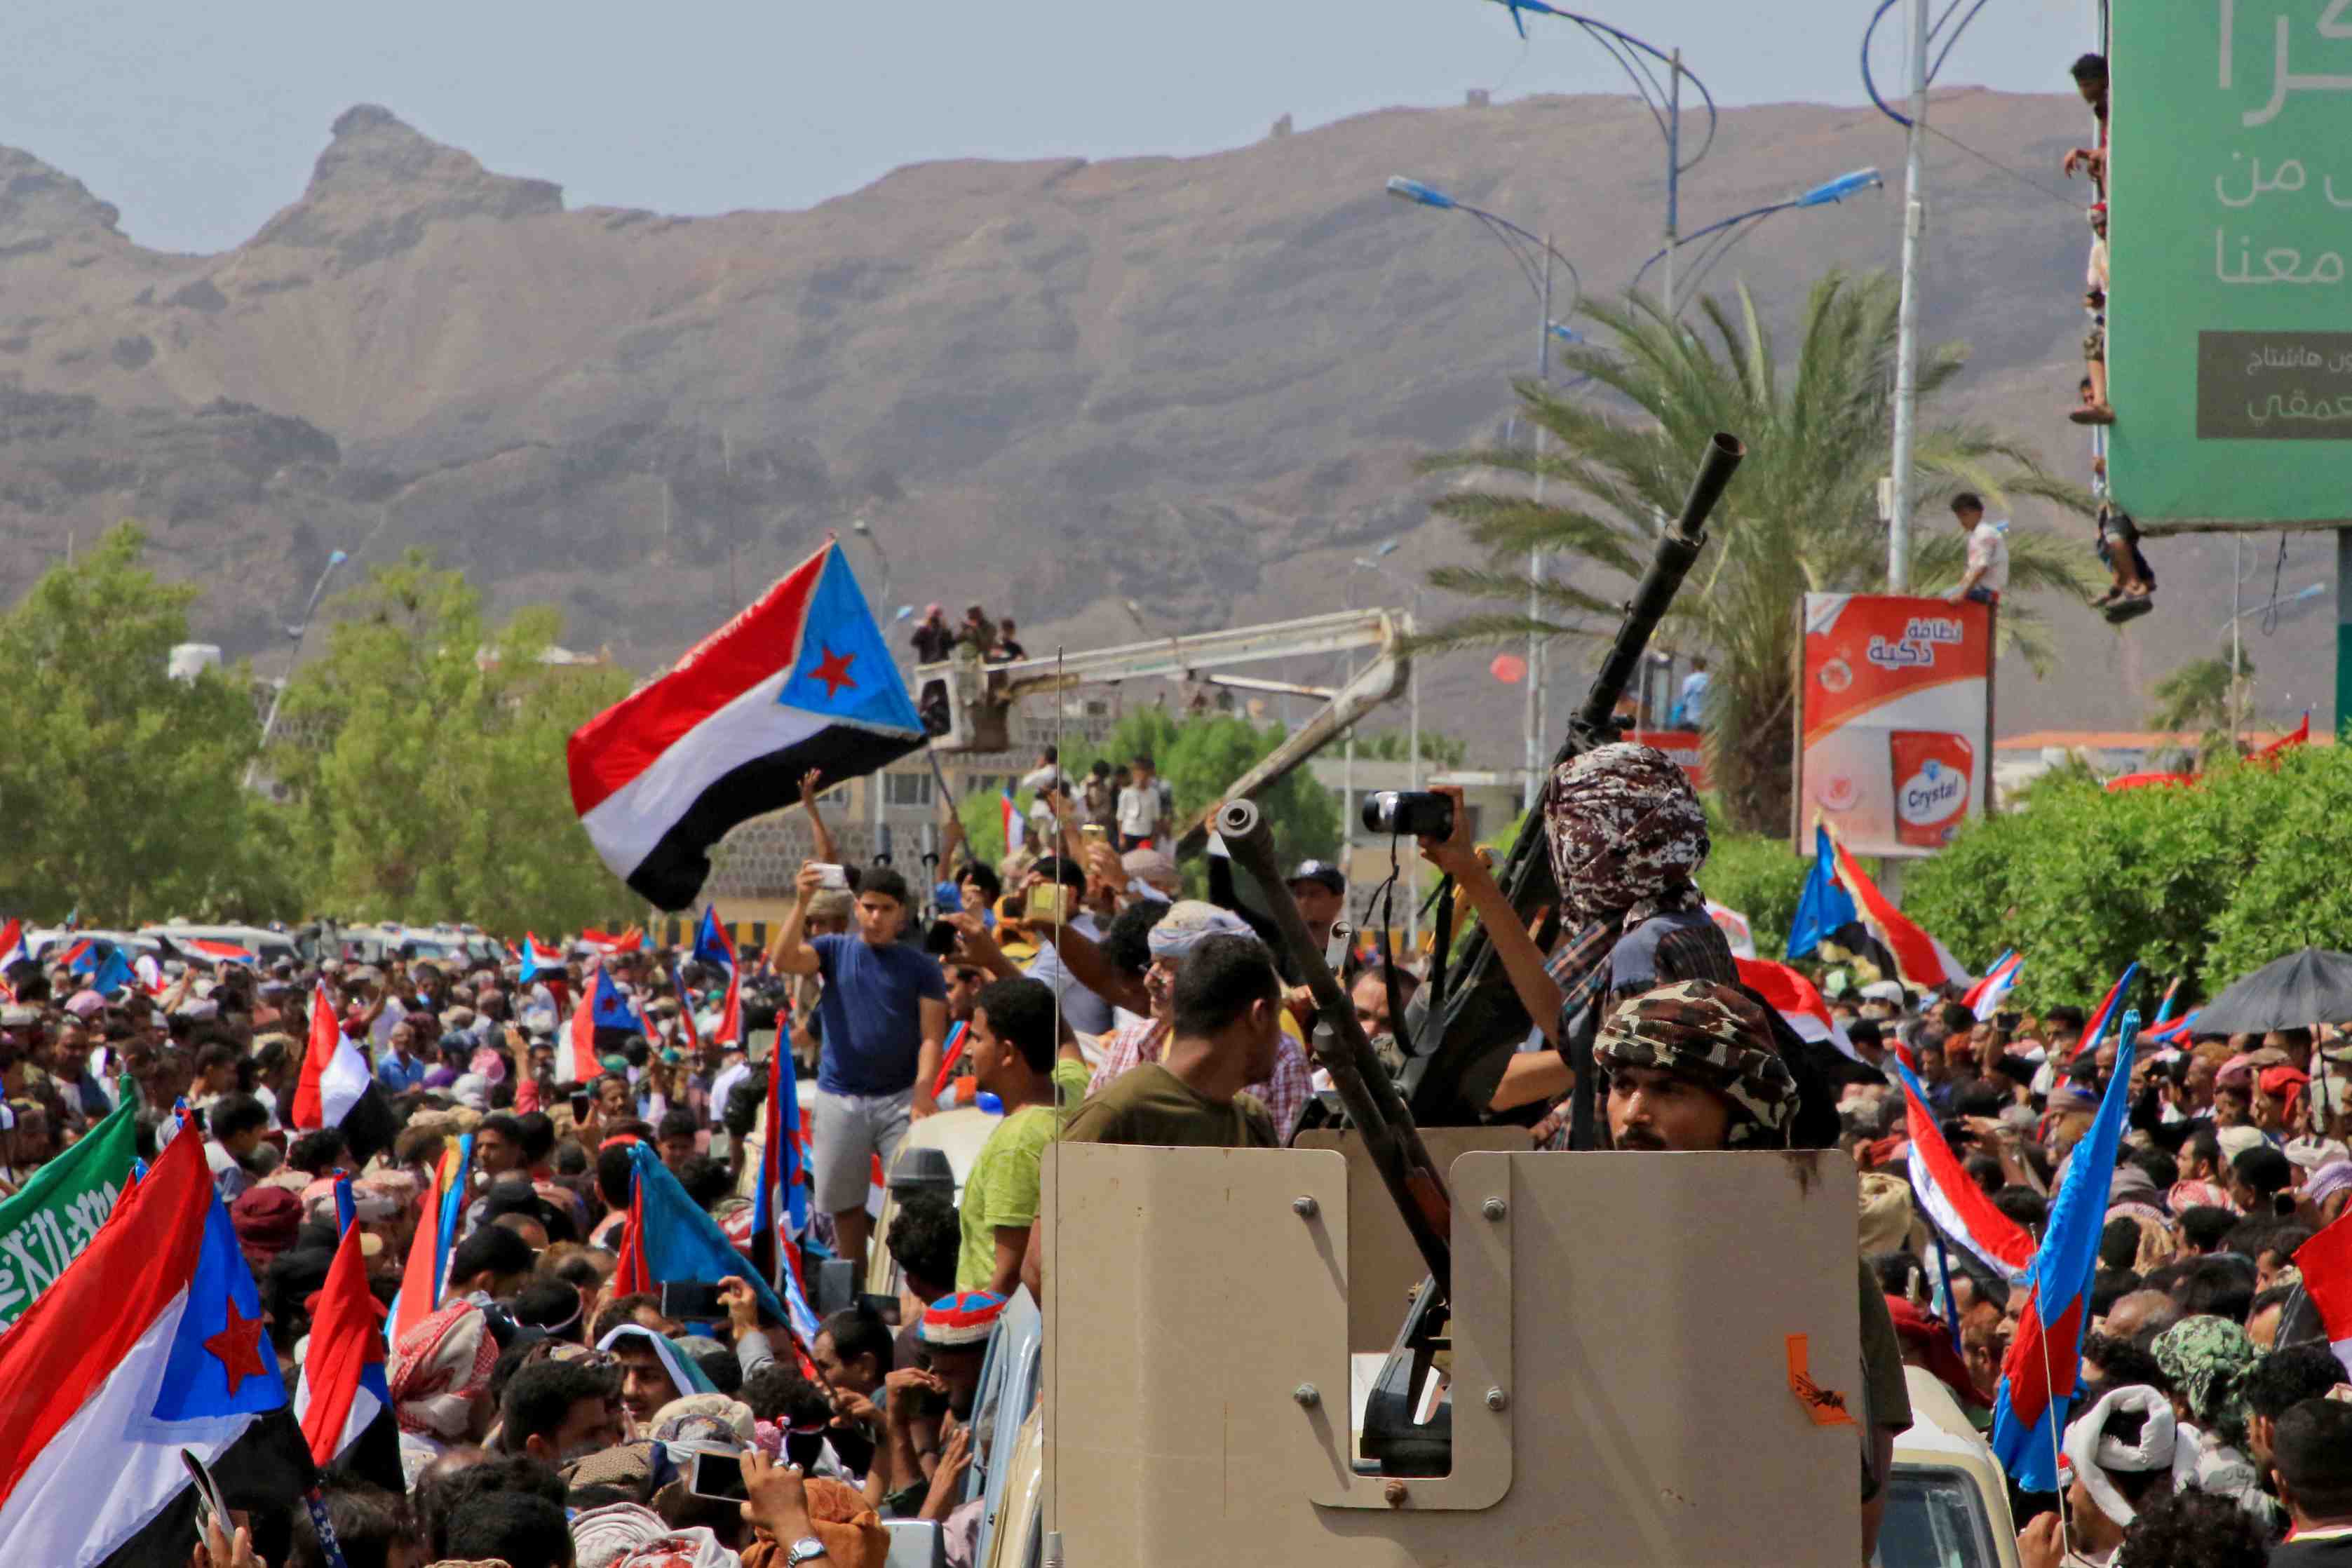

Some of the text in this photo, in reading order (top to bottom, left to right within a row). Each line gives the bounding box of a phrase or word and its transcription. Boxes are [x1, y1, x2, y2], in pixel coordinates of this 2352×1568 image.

[2216, 151, 2305, 207] من
[2215, 227, 2345, 283] معنا
[1867, 637, 1933, 669] ذكية
[1908, 773, 1959, 809] Crystal
